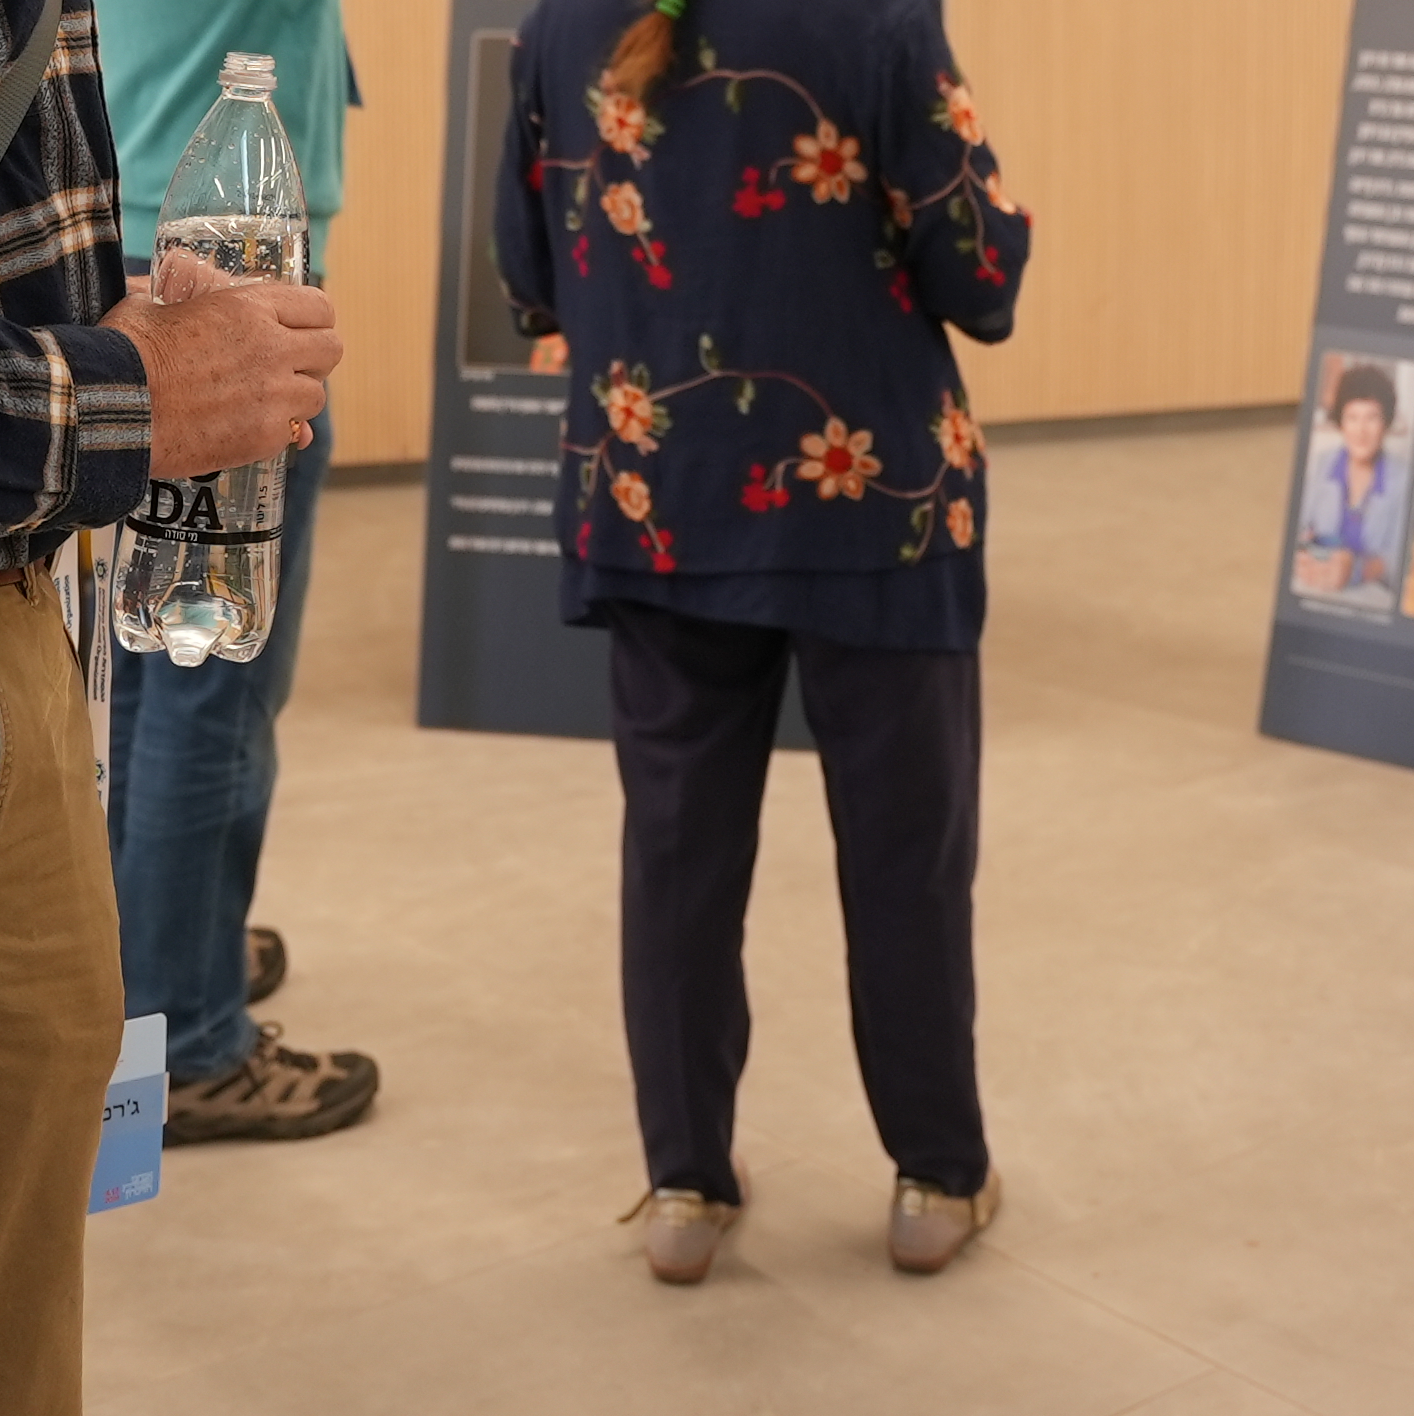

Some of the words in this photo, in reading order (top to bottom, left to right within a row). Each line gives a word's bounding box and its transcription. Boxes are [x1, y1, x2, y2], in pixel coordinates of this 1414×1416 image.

[146, 479, 223, 531] DA
[164, 529, 186, 541] סודה
[187, 532, 198, 542] מי
